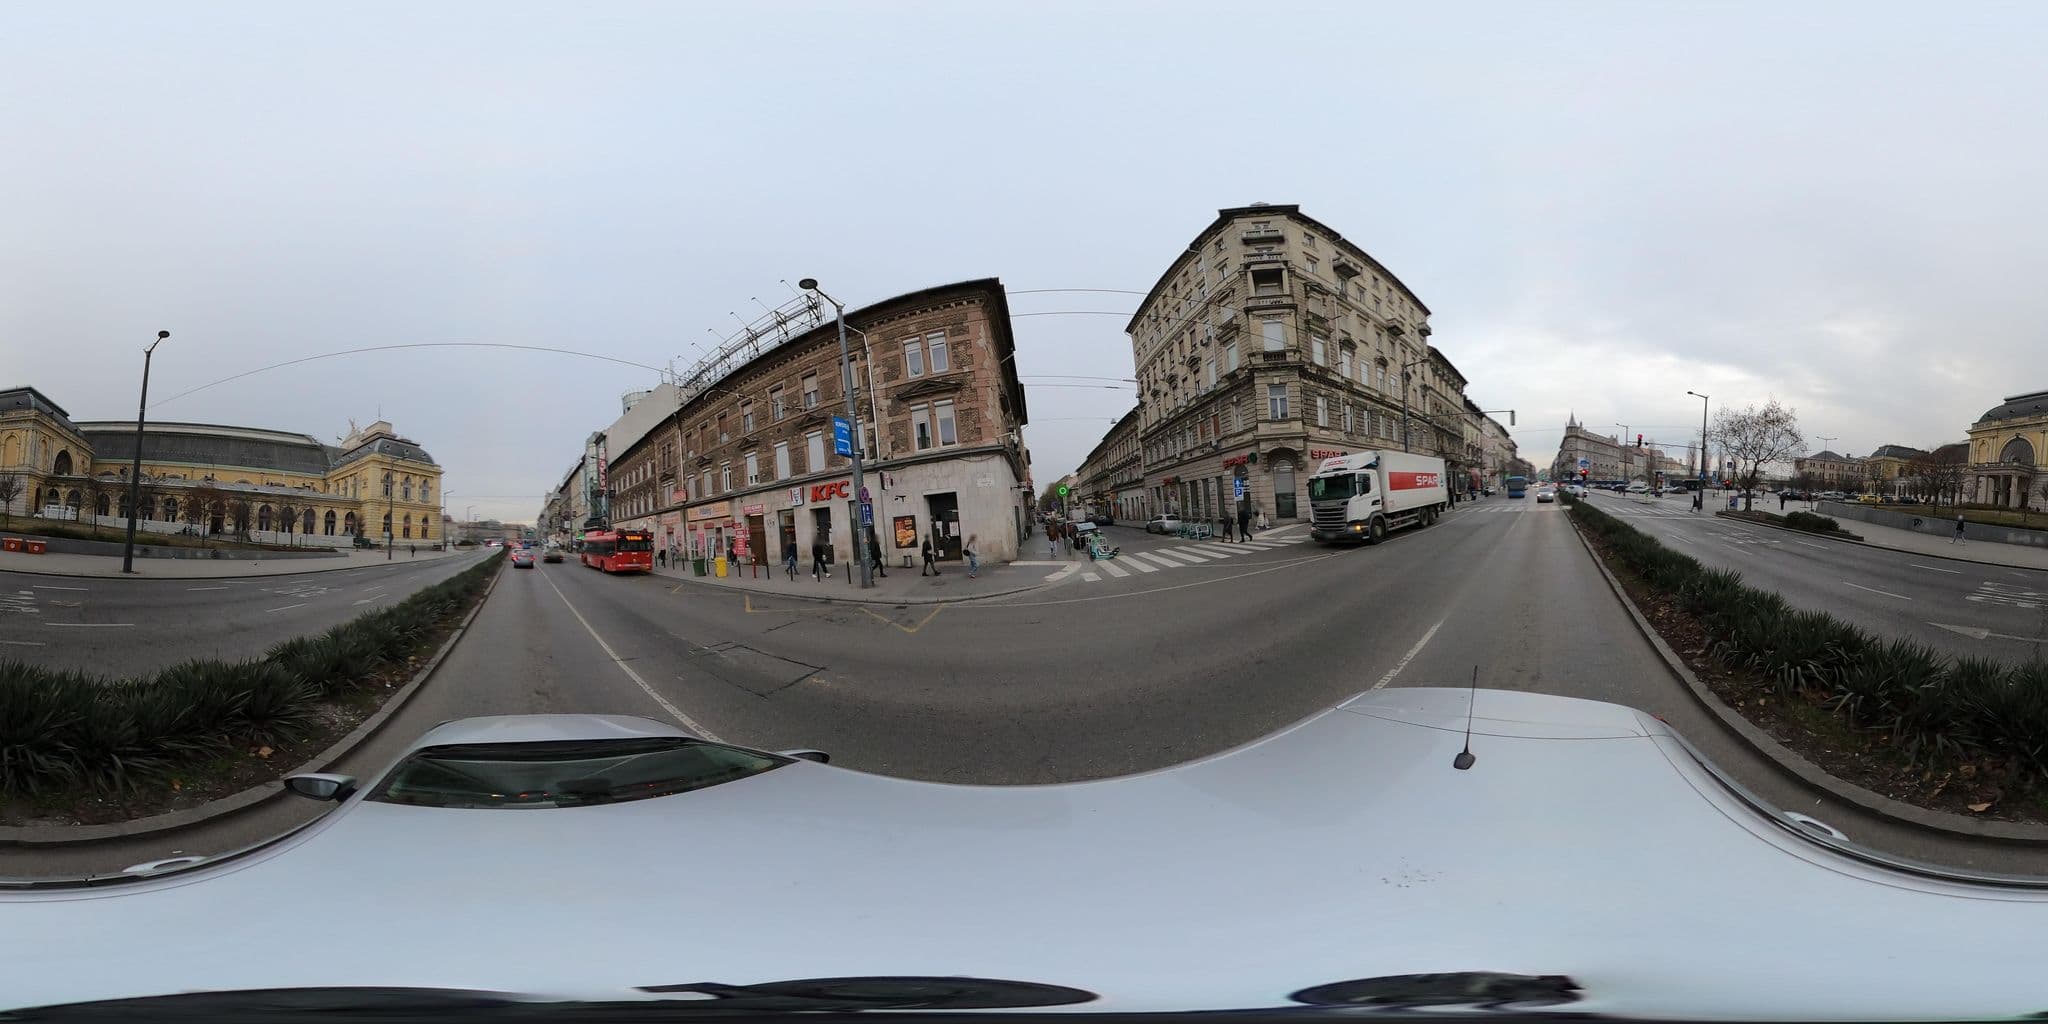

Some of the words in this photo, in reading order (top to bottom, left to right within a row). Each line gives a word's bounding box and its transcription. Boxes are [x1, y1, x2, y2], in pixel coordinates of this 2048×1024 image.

[1311, 448, 1342, 459] SPAR
[1415, 475, 1438, 486] SPAR
[810, 480, 850, 502] KFC
